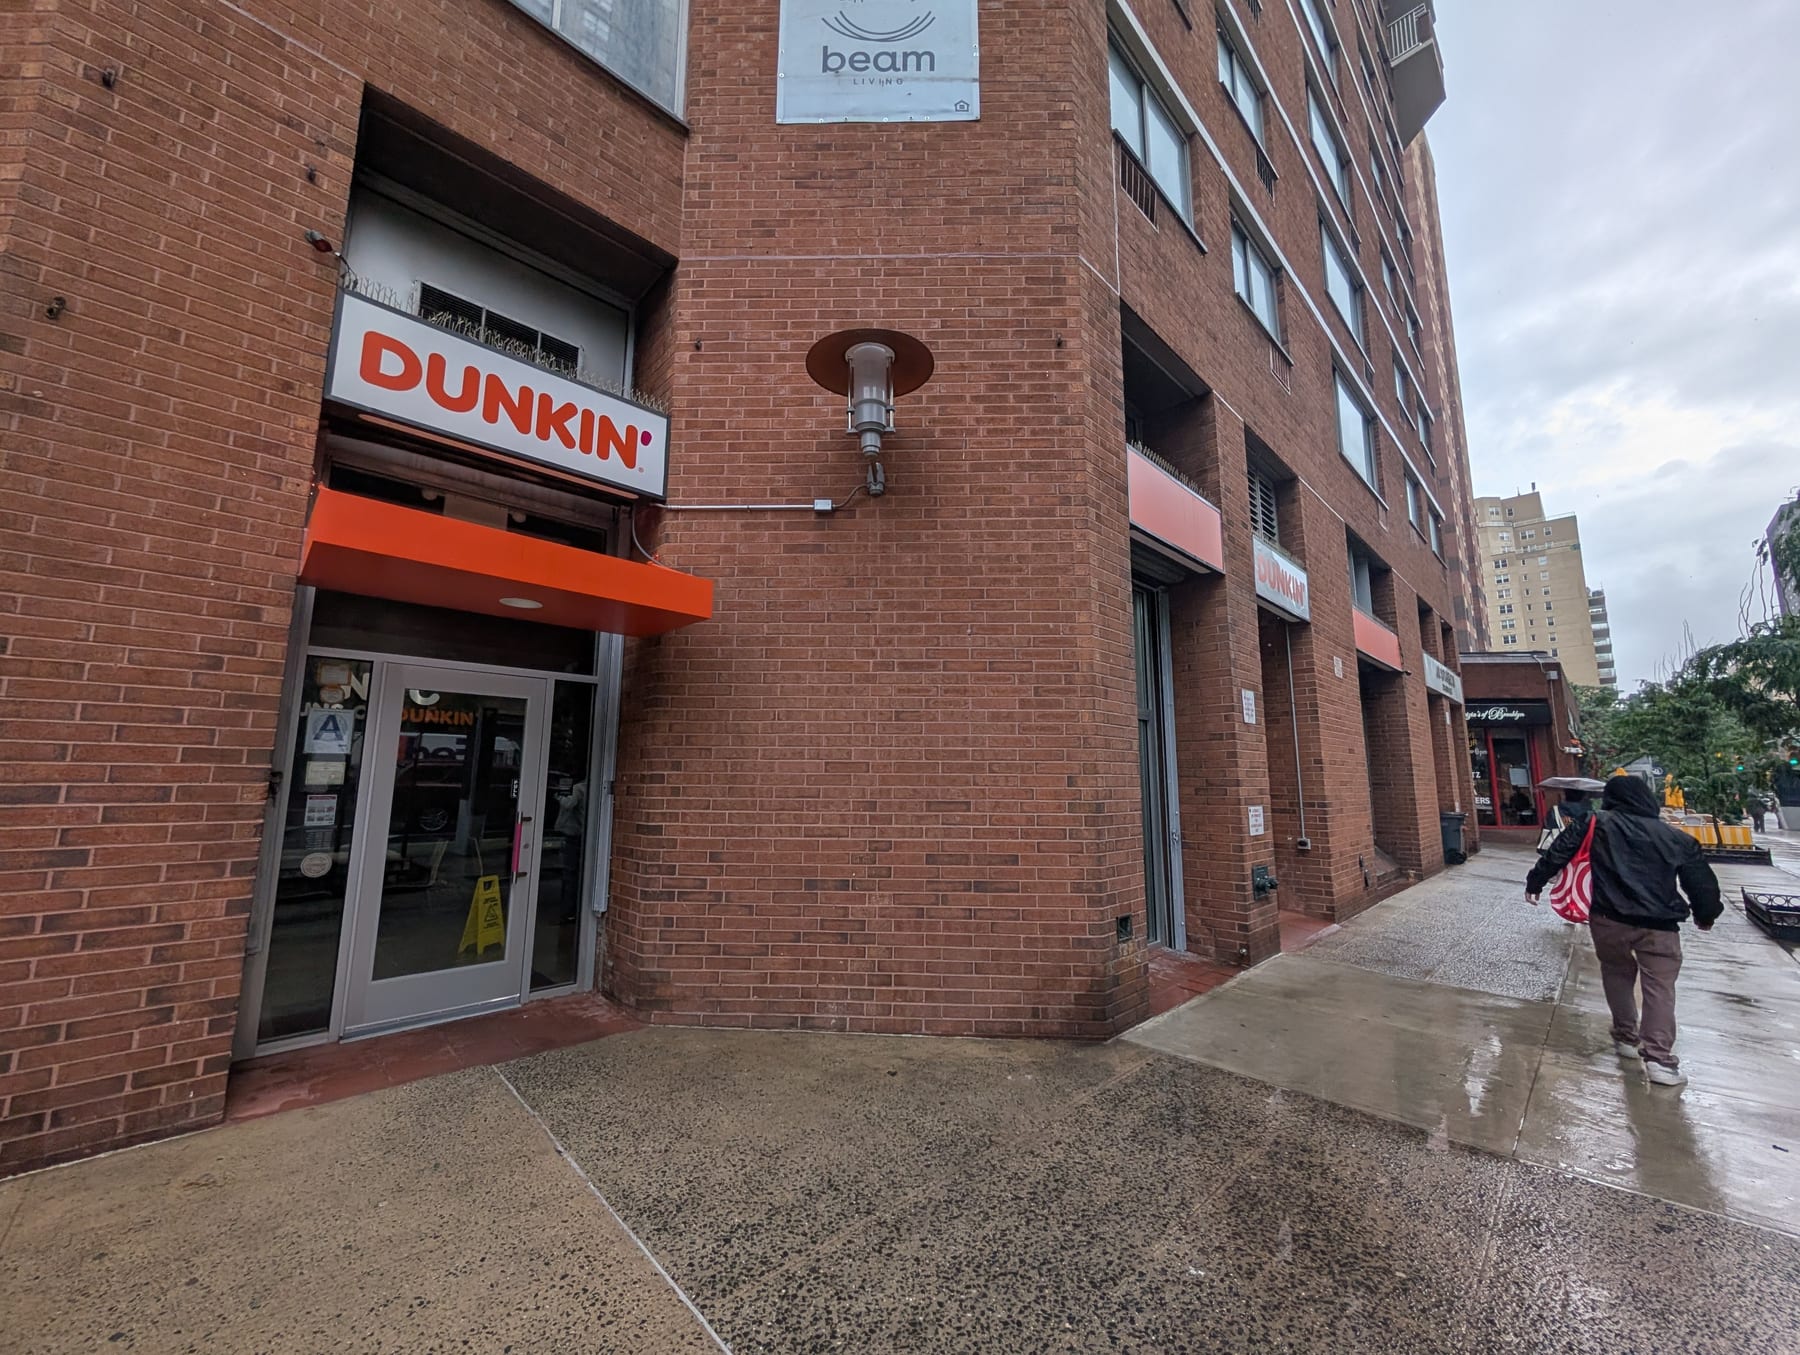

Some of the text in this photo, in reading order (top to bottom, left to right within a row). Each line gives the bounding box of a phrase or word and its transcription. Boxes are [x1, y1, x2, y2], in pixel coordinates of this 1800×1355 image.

[822, 46, 935, 73] beam
[853, 78, 904, 87] LIVING
[360, 331, 652, 469] DUNKIN'
[313, 714, 344, 741] A
